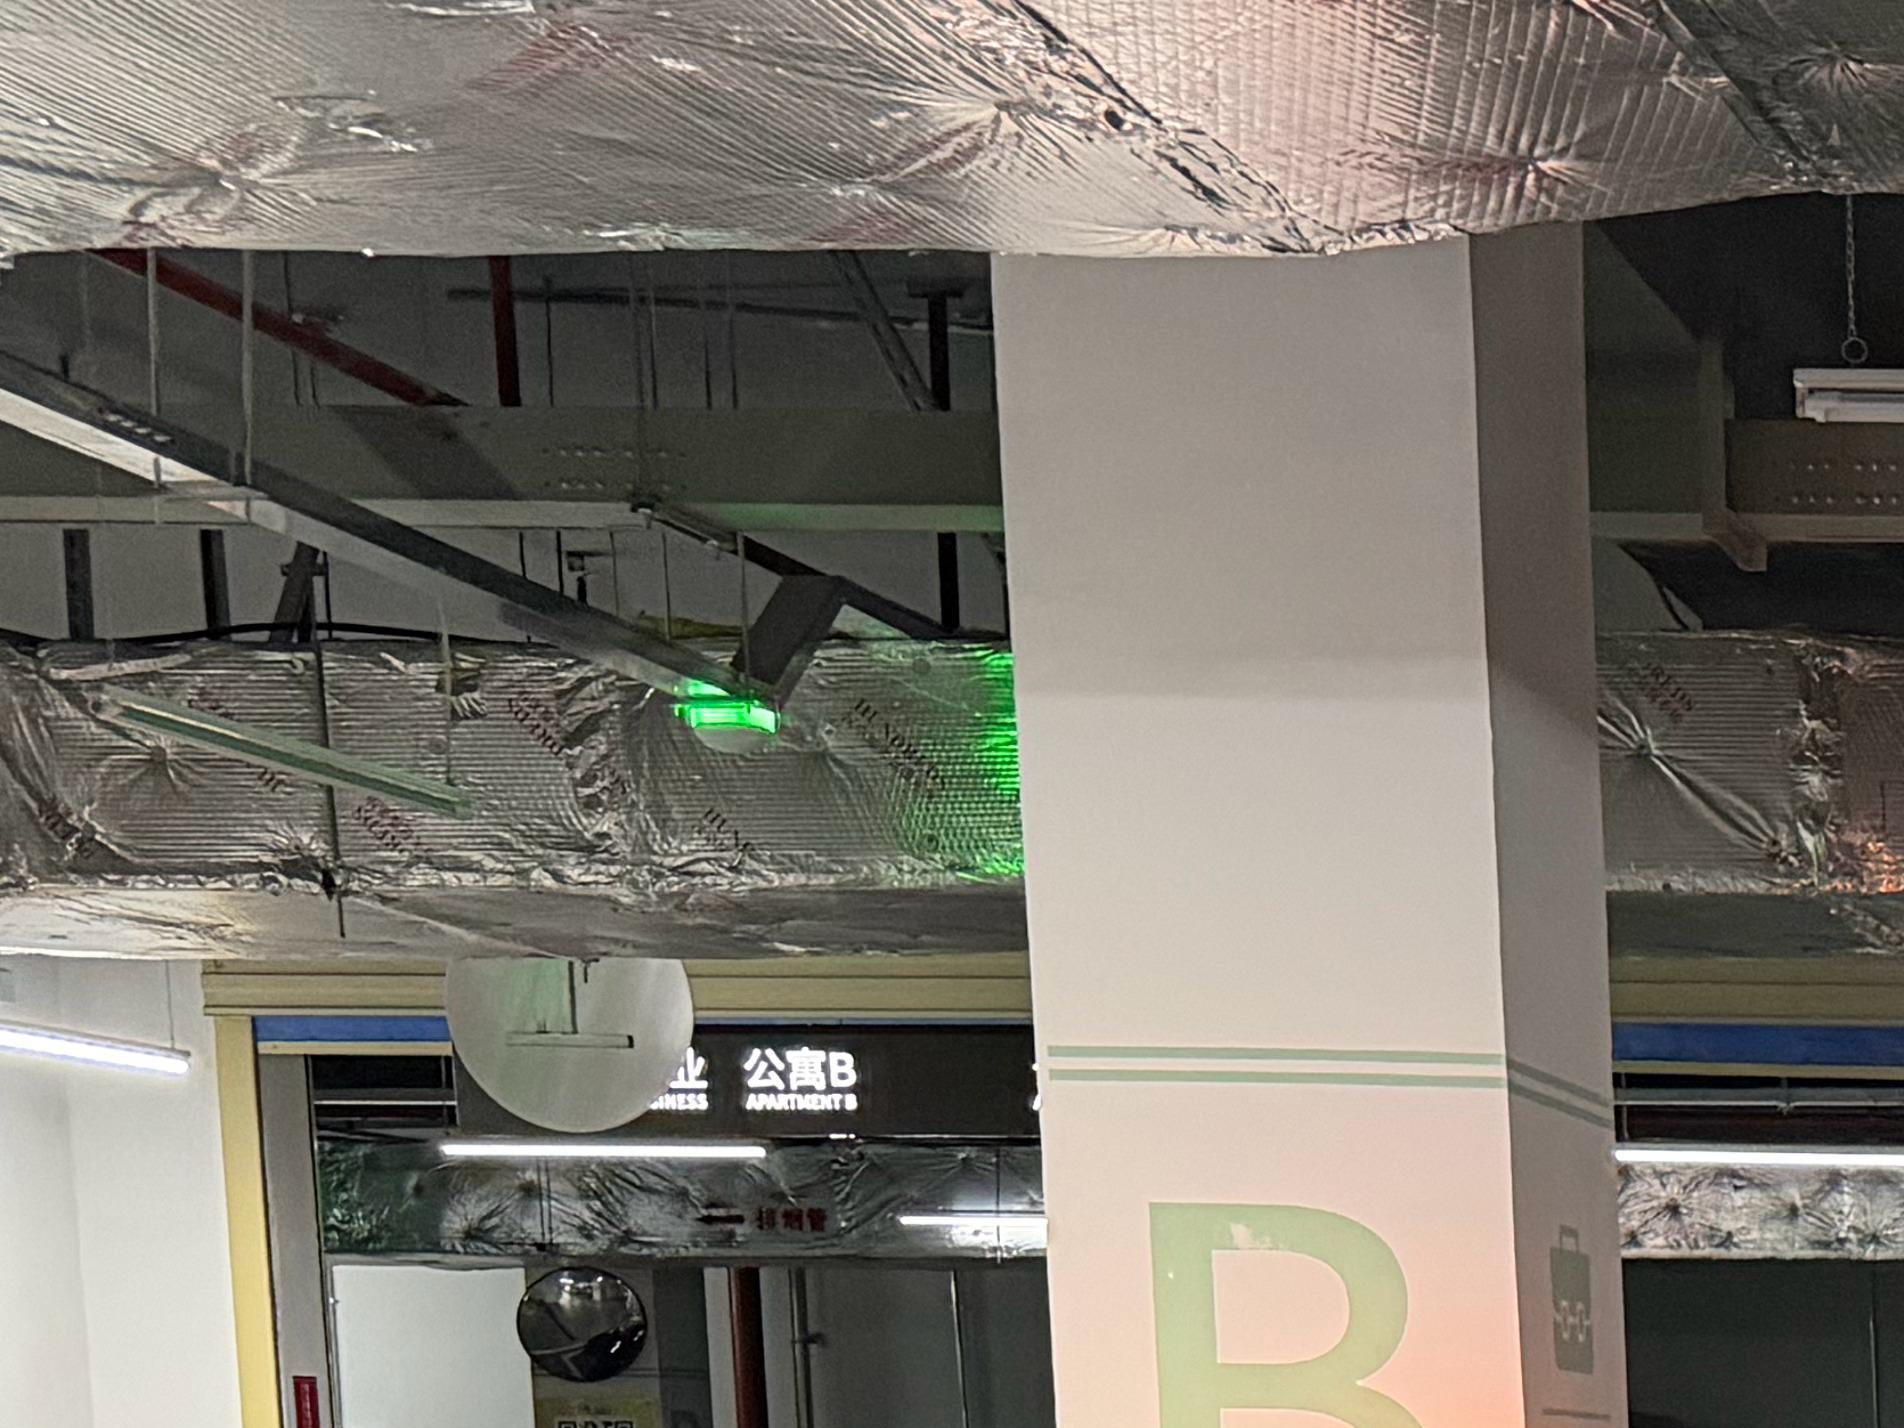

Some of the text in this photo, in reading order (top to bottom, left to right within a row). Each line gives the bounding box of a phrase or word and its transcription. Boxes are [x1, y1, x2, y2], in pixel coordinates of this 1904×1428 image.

[744, 1047, 857, 1091] 公寓B
[746, 1094, 858, 1111] APARTMENT B
